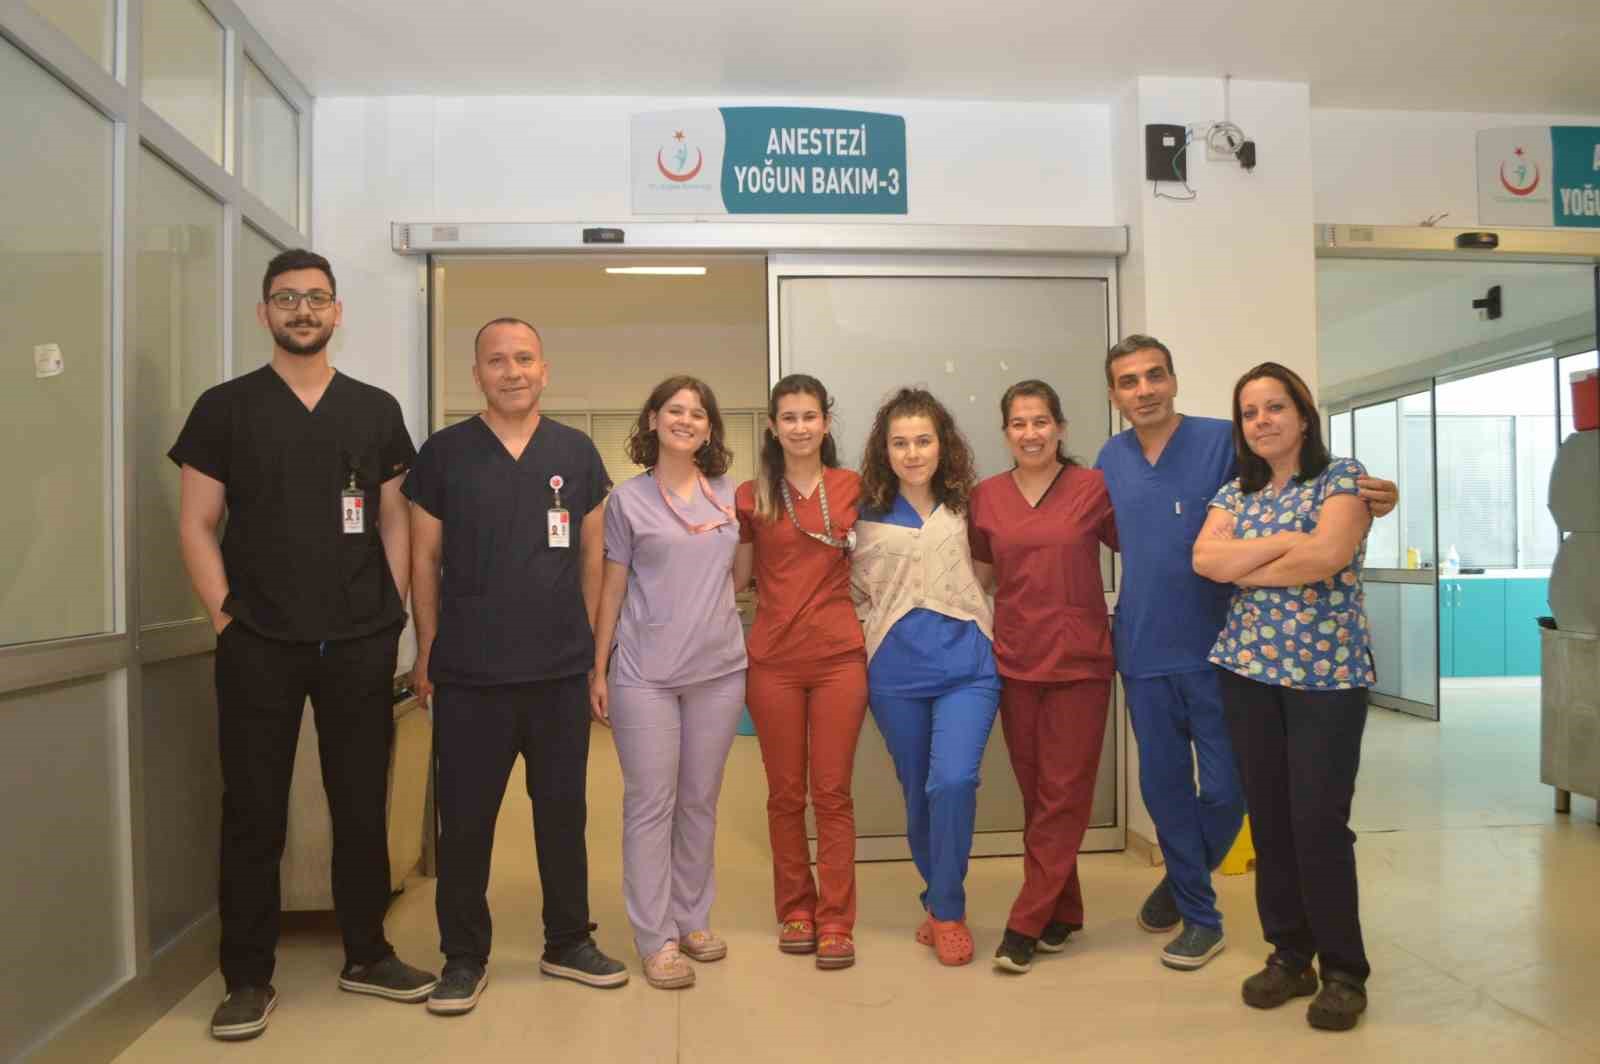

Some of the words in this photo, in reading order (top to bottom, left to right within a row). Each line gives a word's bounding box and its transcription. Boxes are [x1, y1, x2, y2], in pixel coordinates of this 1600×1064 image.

[766, 124, 866, 155] ANESTEZİ
[733, 160, 805, 193] YOĞUN
[812, 168, 900, 195] BAKIM-3
